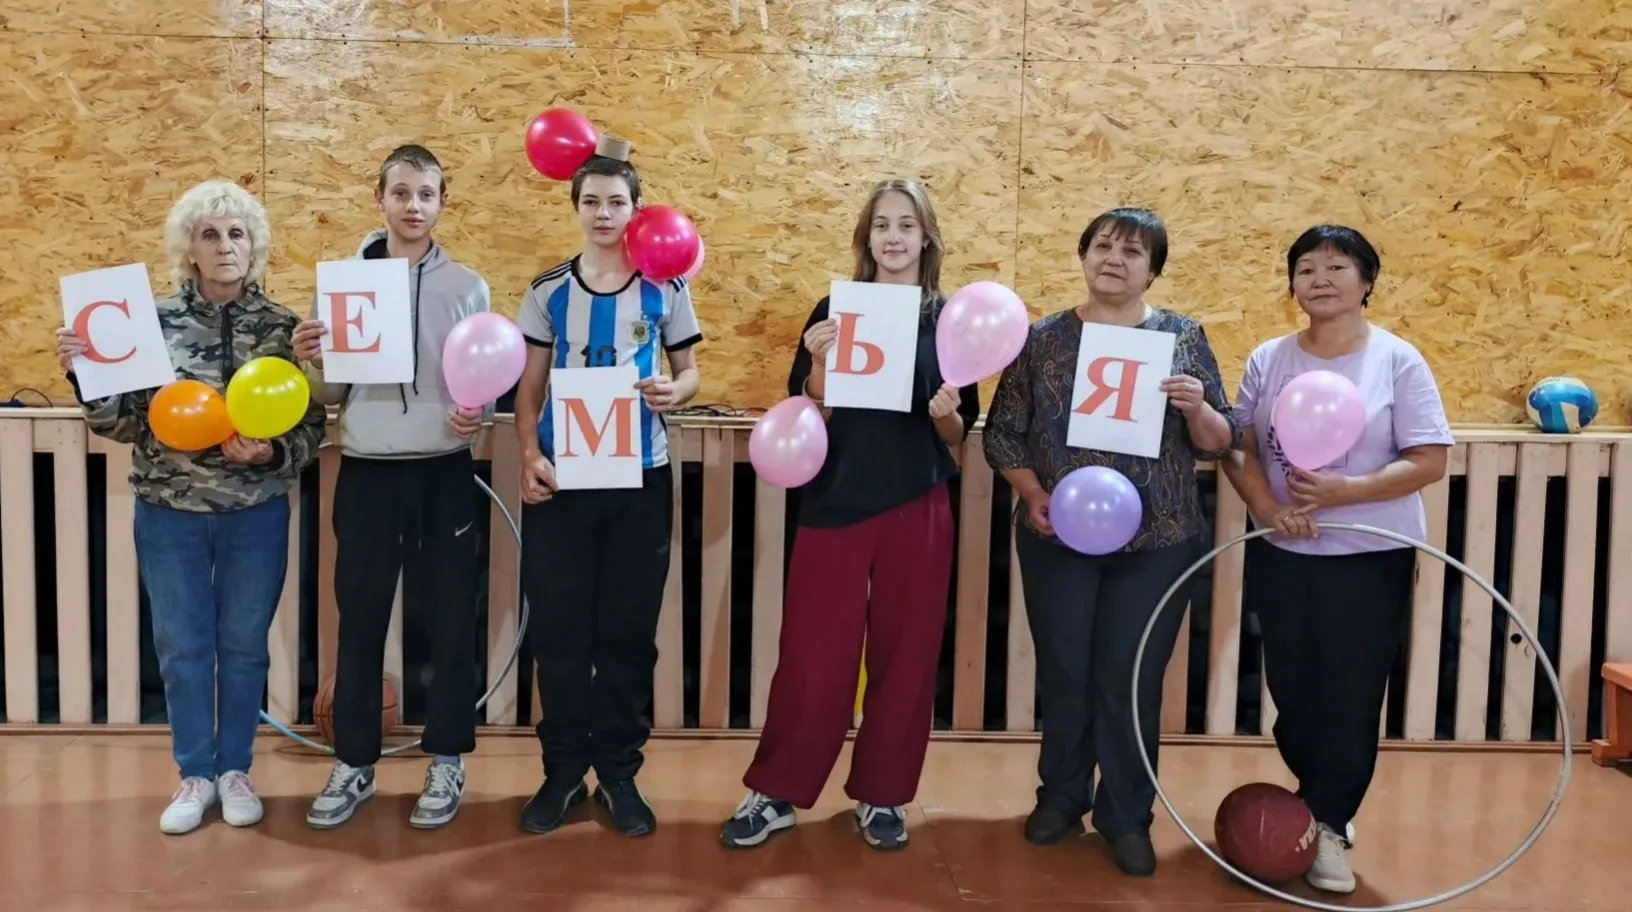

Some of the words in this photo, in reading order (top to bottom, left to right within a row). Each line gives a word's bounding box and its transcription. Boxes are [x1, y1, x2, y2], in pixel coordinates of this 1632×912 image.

[72, 298, 136, 364] С
[322, 291, 381, 353] Е
[828, 311, 885, 375] Ь
[1071, 356, 1148, 422] Я
[557, 398, 638, 457] М
